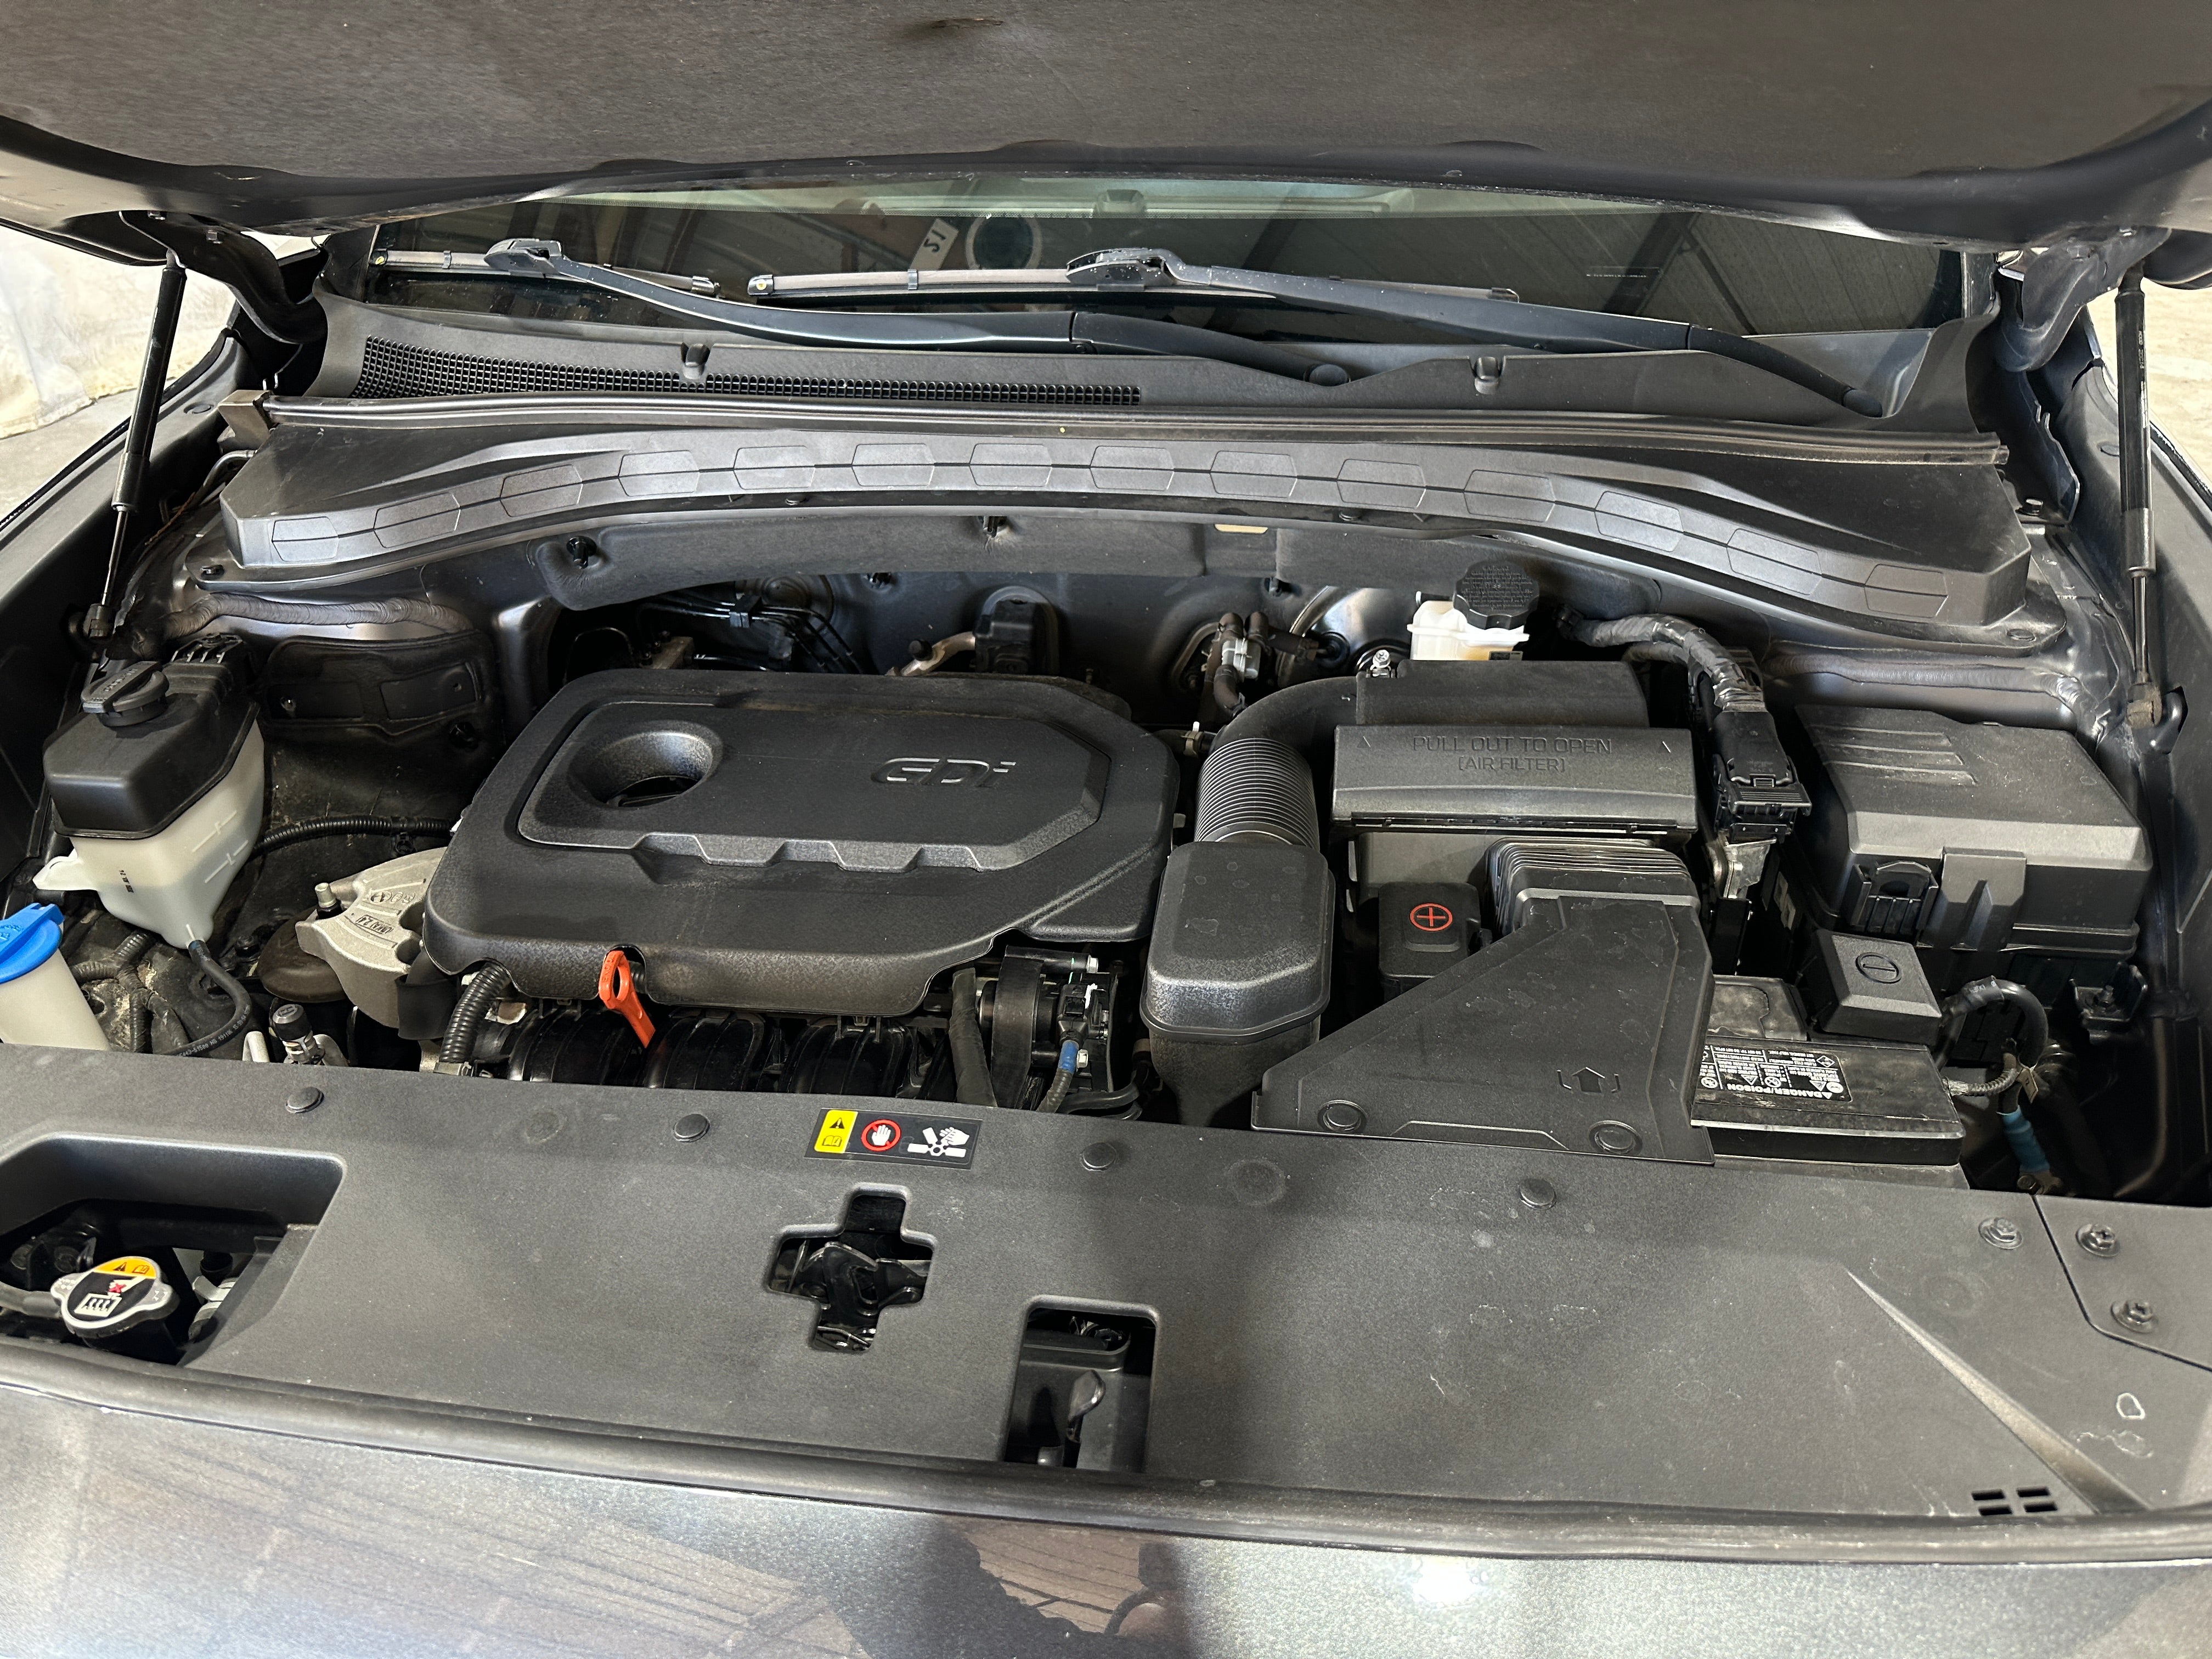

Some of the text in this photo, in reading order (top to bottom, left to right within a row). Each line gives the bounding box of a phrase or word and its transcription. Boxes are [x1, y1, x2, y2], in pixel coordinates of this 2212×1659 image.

[1413, 736, 1611, 755] PULL OUT TO OPEN
